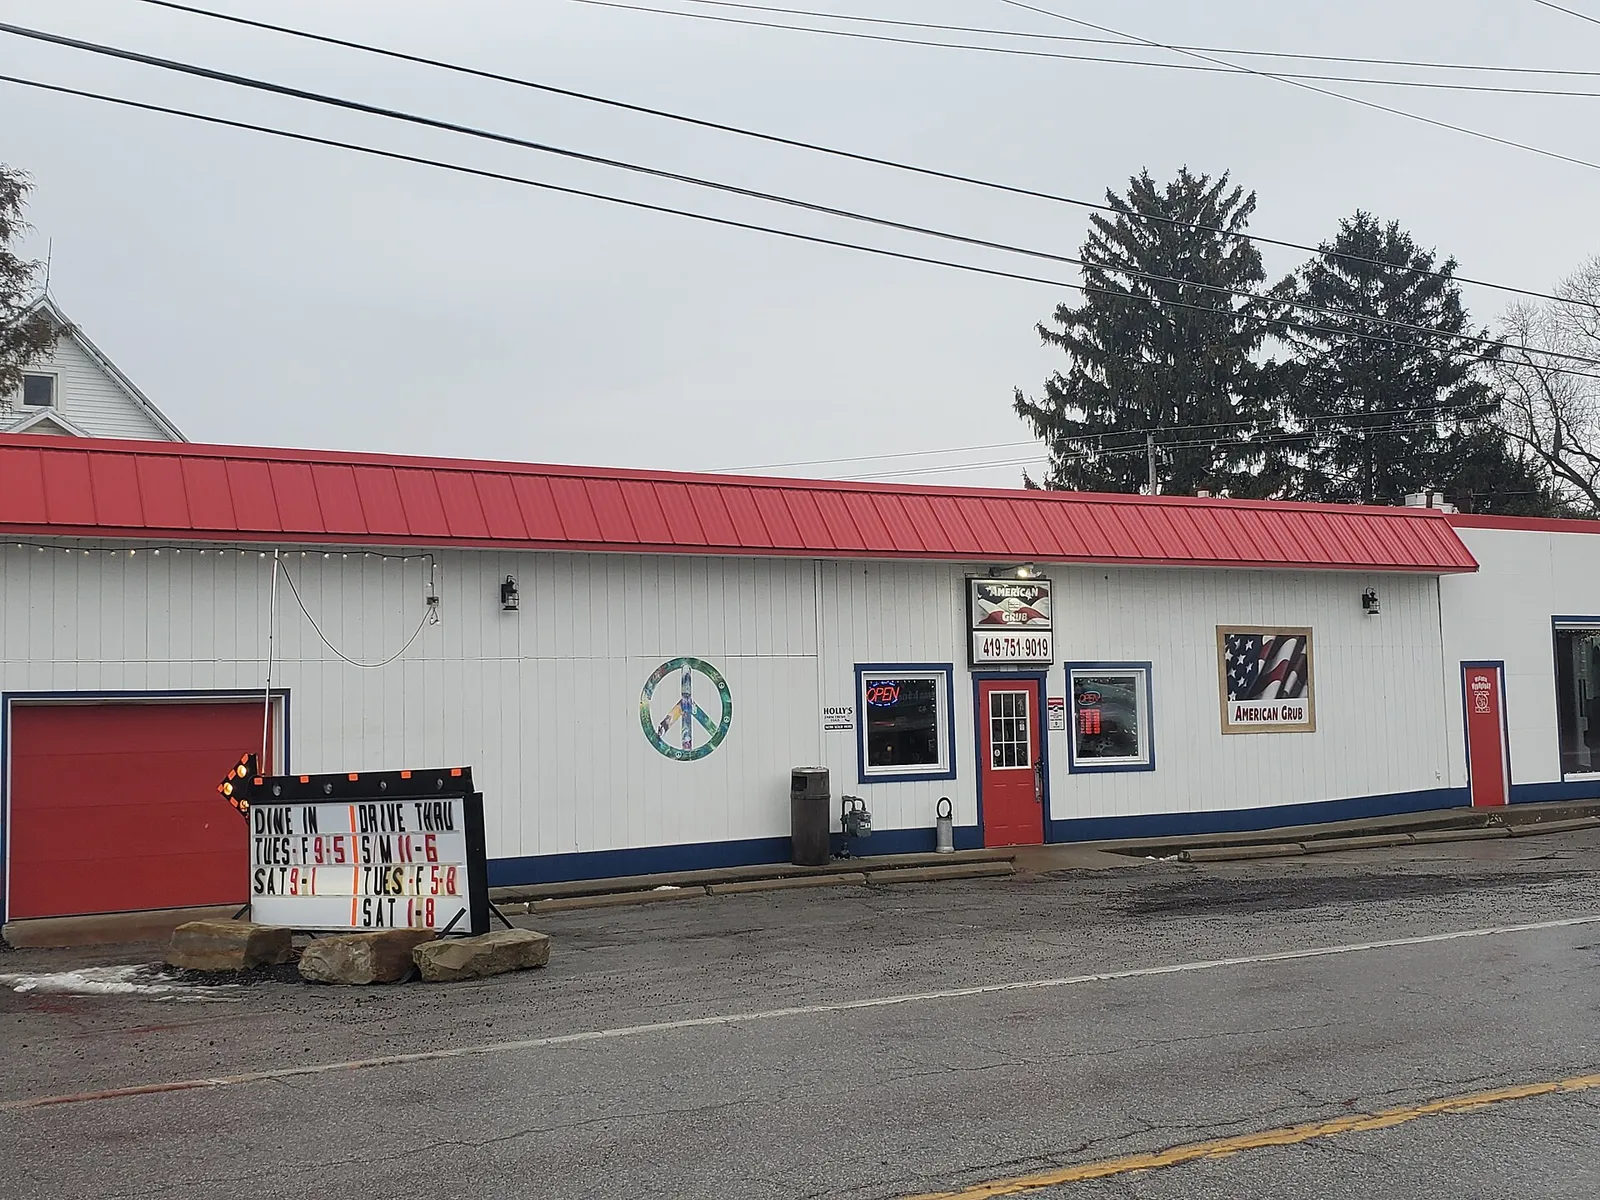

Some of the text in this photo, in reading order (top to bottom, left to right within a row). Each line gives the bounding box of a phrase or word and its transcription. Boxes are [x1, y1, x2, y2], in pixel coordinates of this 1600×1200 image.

[988, 585, 1039, 597] AMERICAN
[1002, 612, 1028, 622] GRUB
[867, 686, 900, 702] OPEN
[823, 706, 853, 715] HOLLY'S
[1235, 705, 1303, 721] AMERICAN GRUB
[254, 806, 318, 835] DINE IN
[359, 801, 453, 833] DRIVE THRU
[362, 898, 396, 927] SAT
